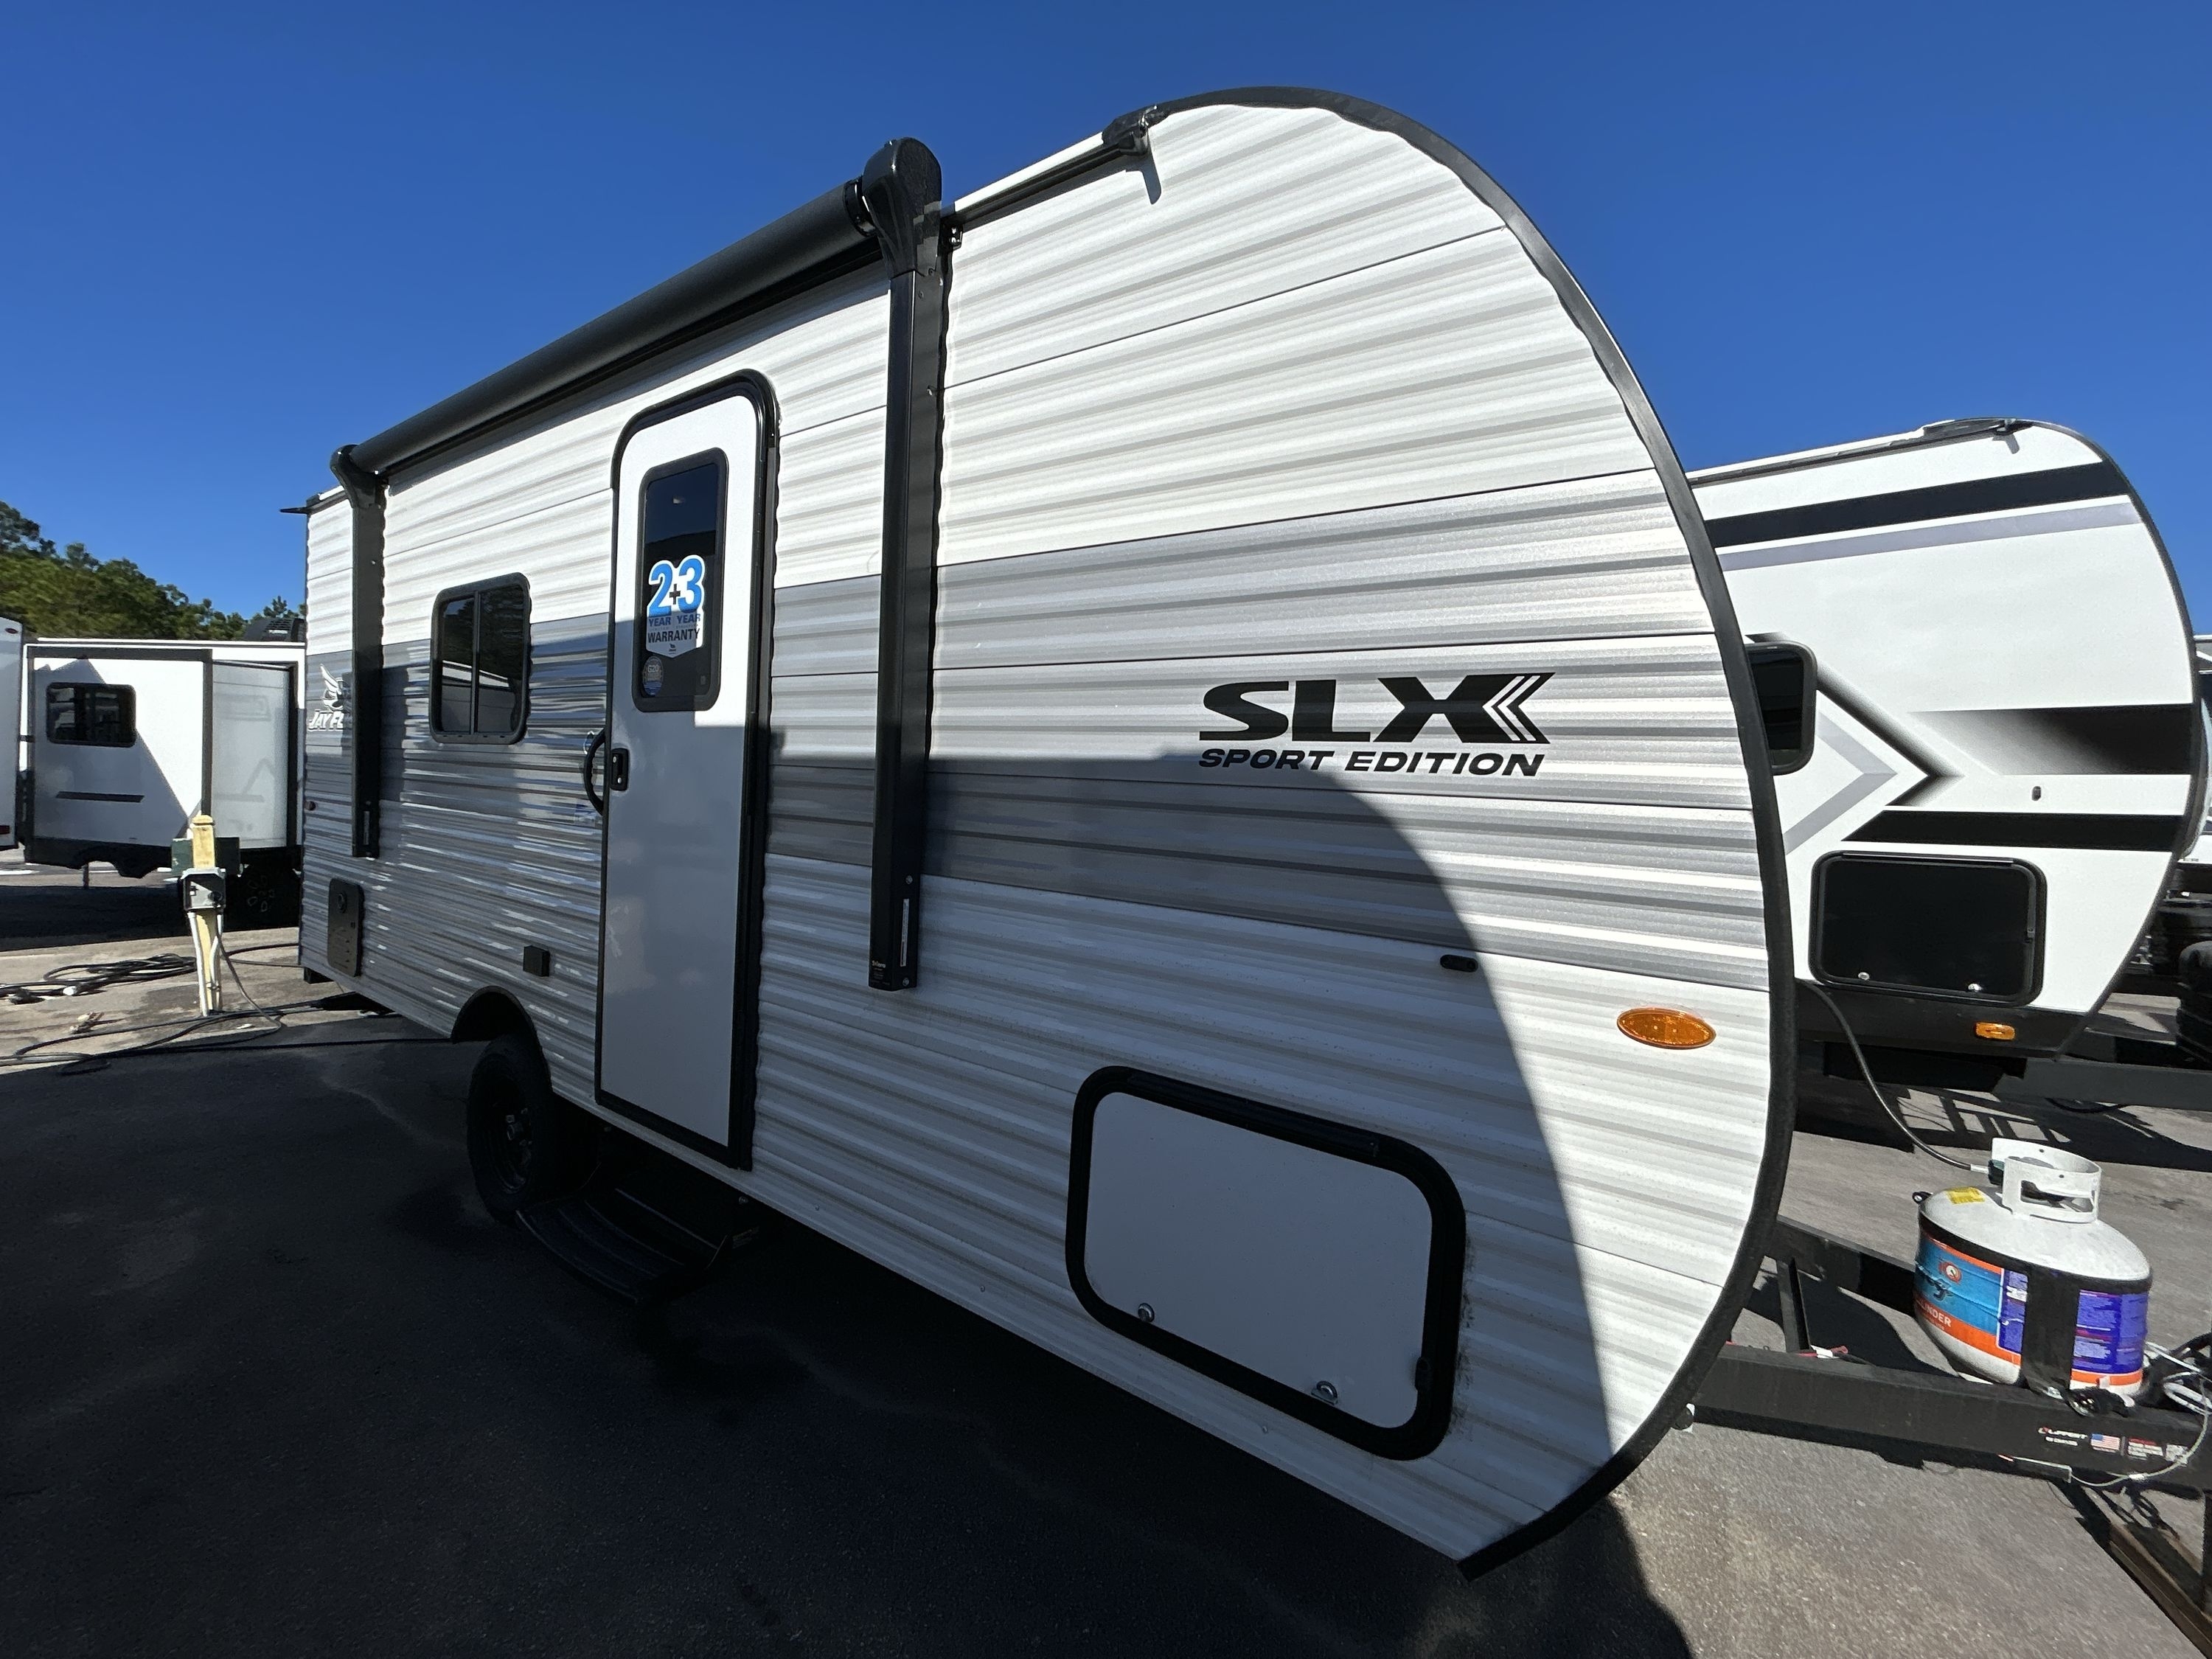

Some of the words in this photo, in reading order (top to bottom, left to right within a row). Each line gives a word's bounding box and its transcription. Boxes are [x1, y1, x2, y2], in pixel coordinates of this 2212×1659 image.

[649, 616, 671, 627] YEAR
[677, 613, 700, 624] YEAR
[647, 627, 700, 643] WARRANTY
[1199, 672, 1557, 744] SLX
[307, 710, 333, 729] JAY
[1198, 748, 1335, 771] SPORT
[1344, 751, 1545, 777] EDITION
